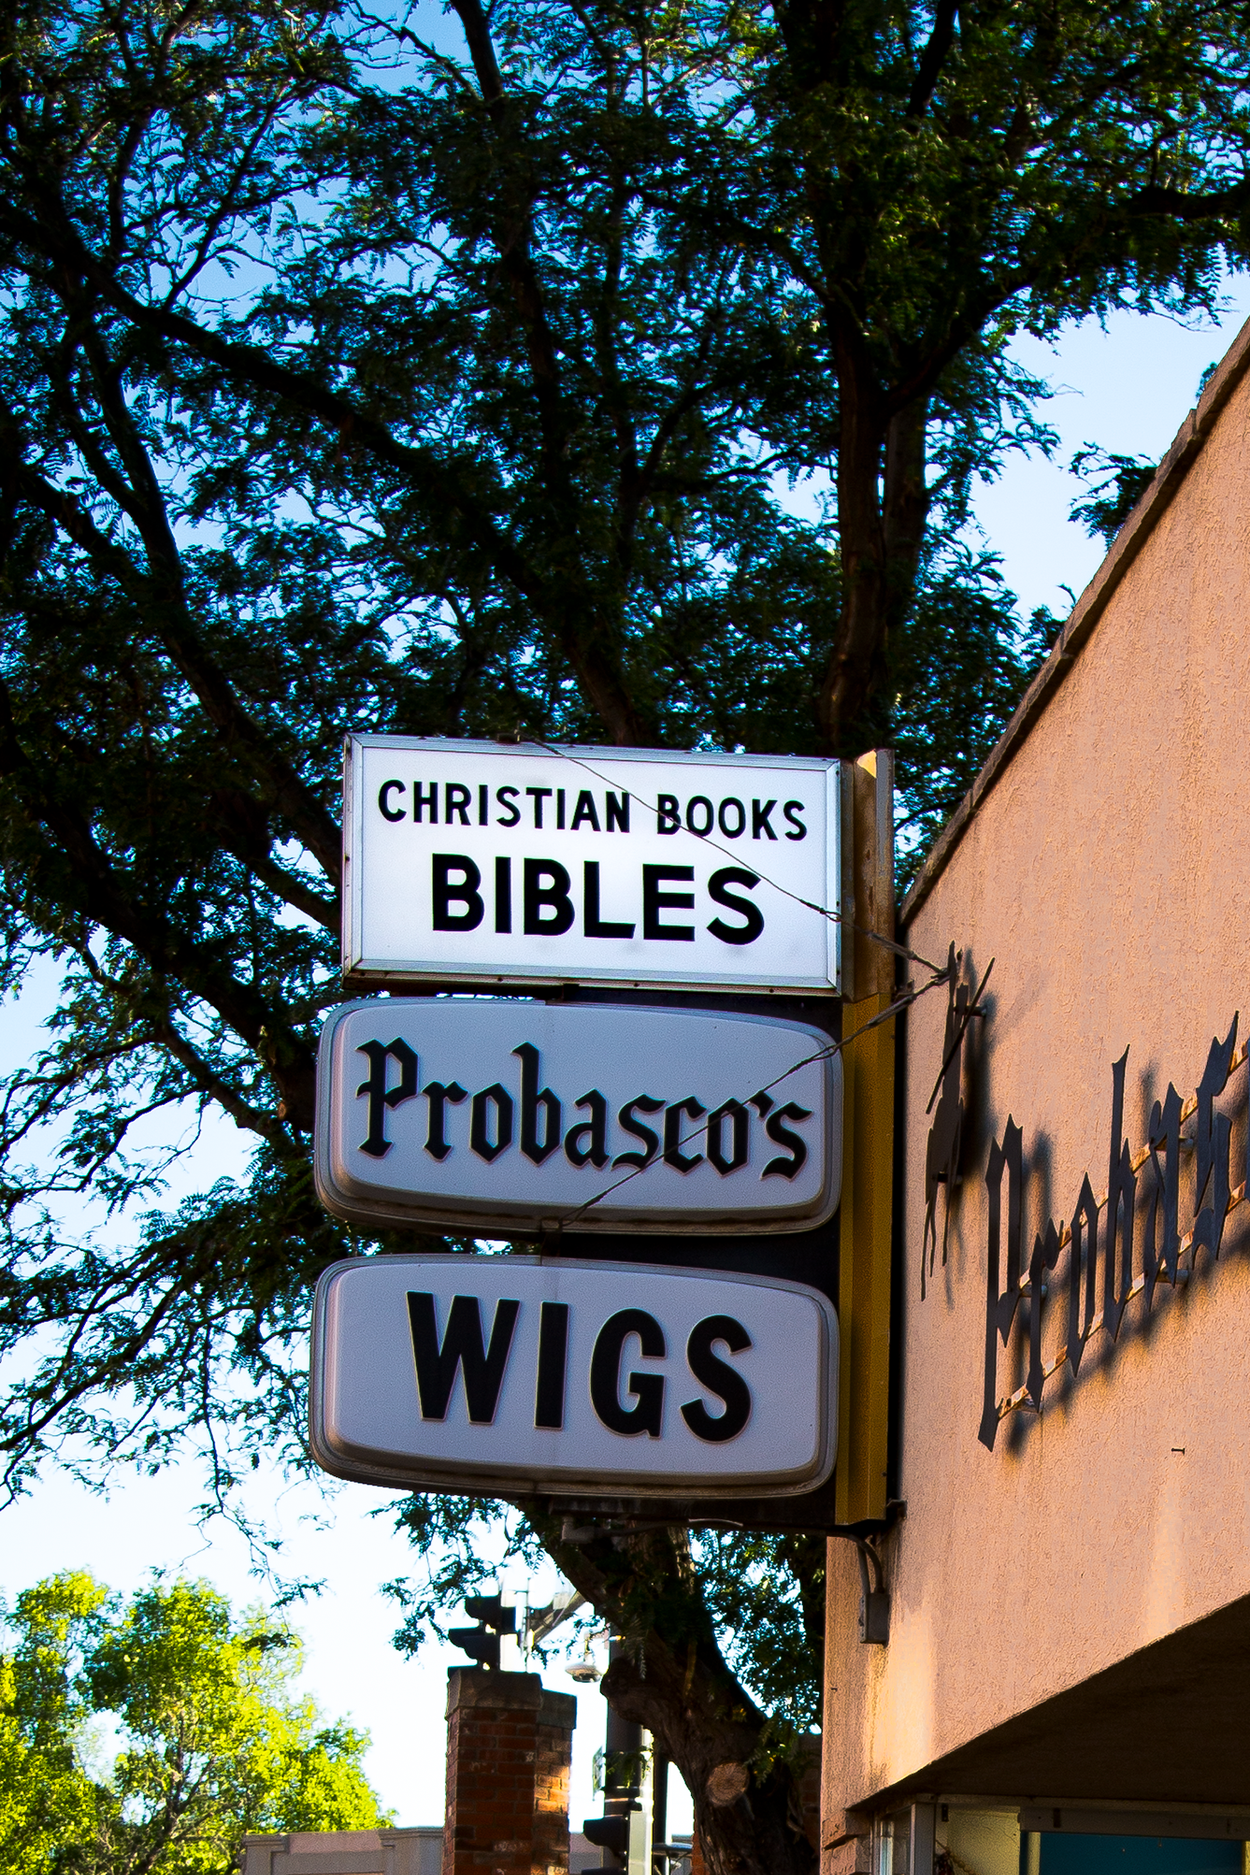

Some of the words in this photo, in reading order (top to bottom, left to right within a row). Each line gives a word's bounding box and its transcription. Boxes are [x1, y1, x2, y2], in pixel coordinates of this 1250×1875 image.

[378, 779, 630, 833] CHRISTIAN
[656, 794, 808, 841] BOOKS
[432, 853, 765, 946] BIBLES
[356, 1037, 813, 1181] Probasco's
[406, 1291, 752, 1443] WIGS
